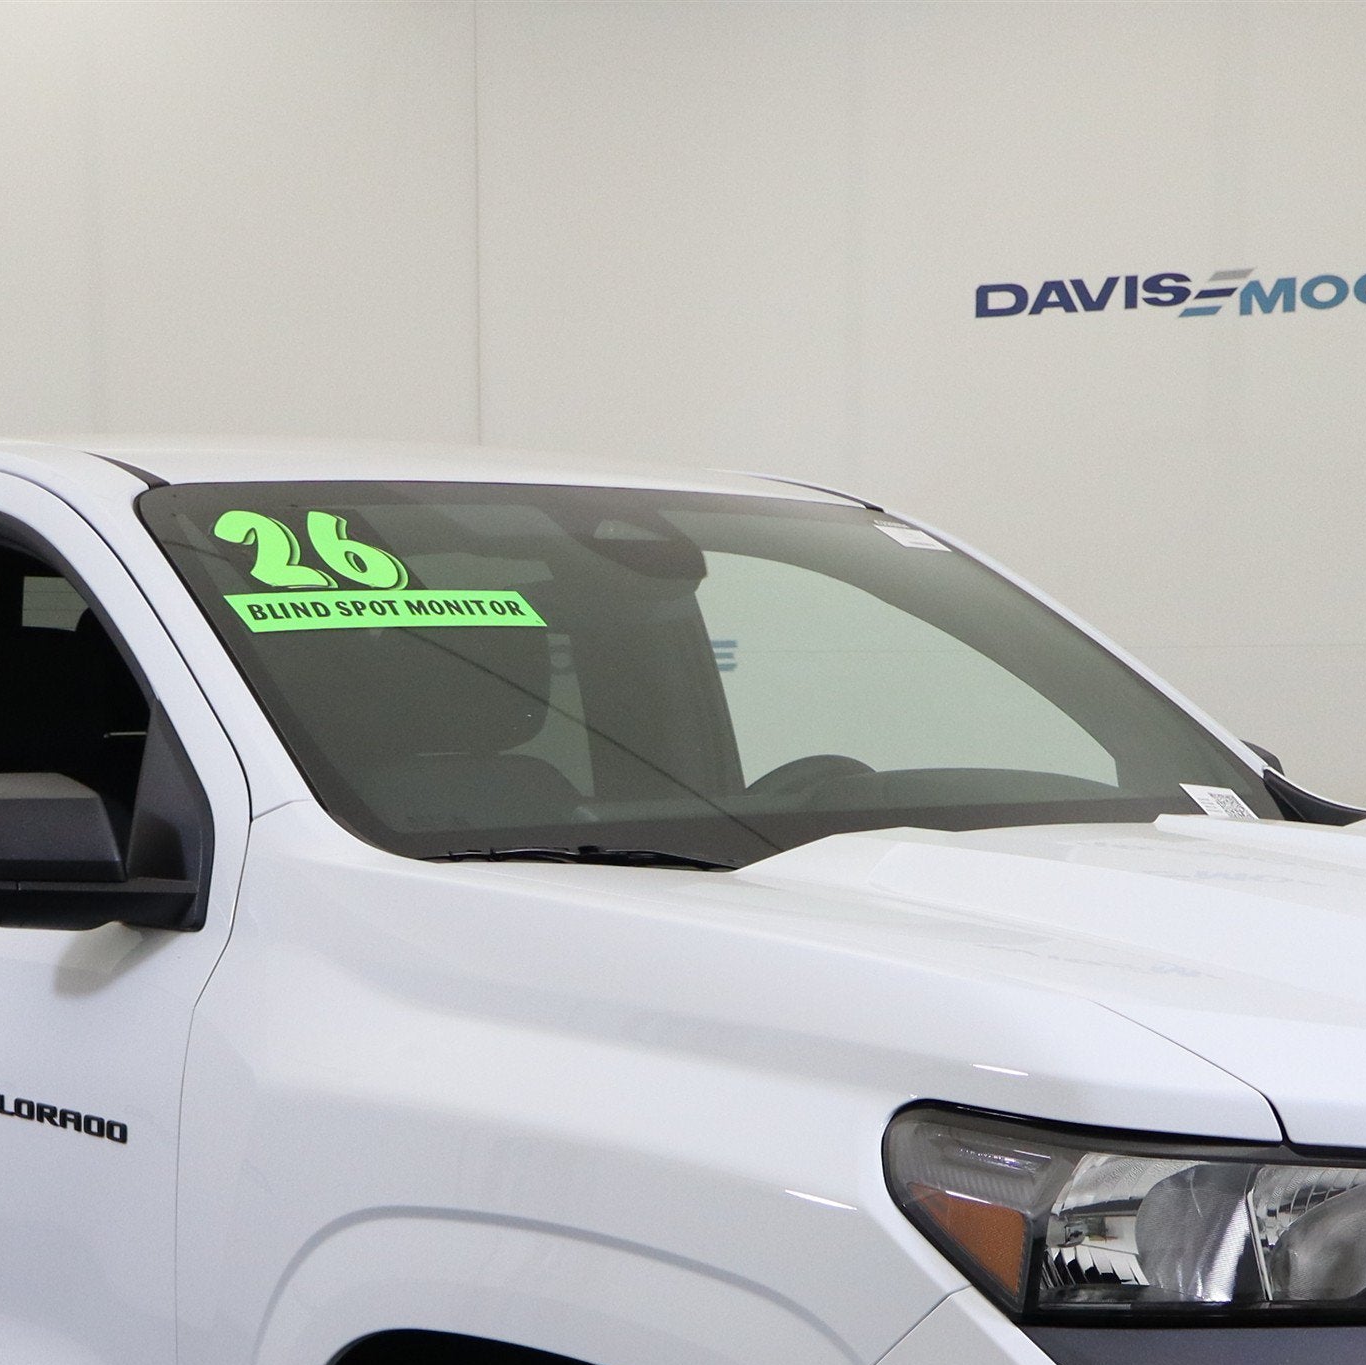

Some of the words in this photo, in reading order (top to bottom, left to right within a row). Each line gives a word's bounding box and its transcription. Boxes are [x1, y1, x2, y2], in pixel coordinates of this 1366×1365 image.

[975, 272, 1193, 318] DAVIS
[213, 510, 409, 590] 26
[246, 602, 331, 621] BLIND
[339, 600, 401, 618] SPOT
[405, 599, 526, 617] MONITOR
